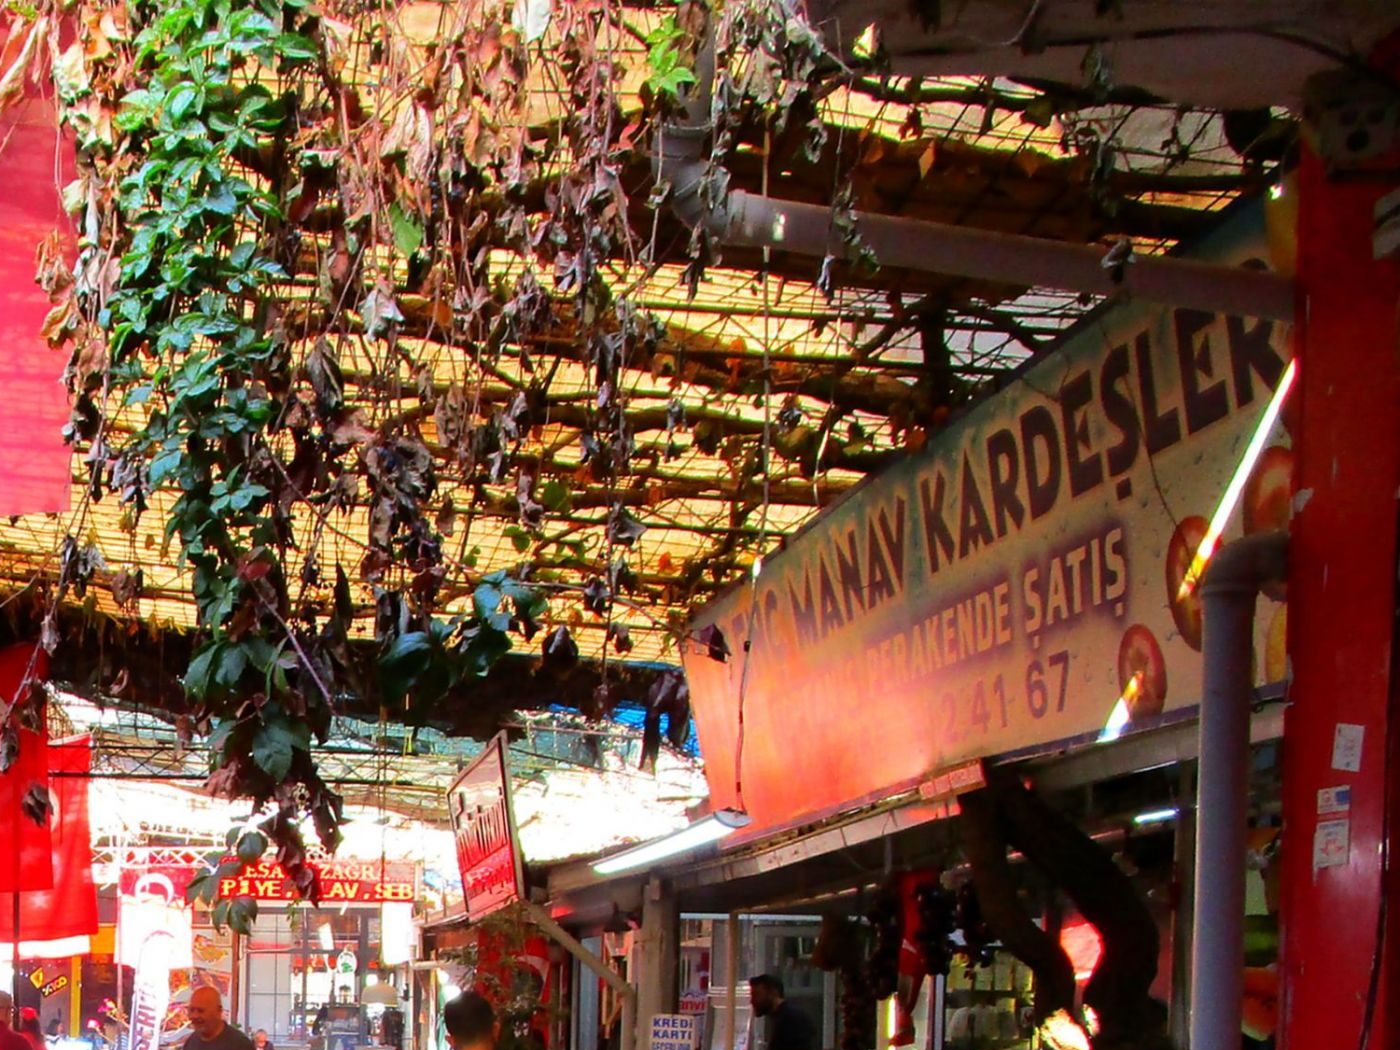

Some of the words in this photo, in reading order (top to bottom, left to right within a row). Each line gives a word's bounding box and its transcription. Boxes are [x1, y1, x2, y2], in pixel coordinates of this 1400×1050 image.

[786, 498, 905, 647] MANAV
[971, 673, 1008, 735] 41
[1025, 649, 1070, 720] 67
[653, 1018, 693, 1028] KREDİ
[653, 1029, 692, 1040] KARTI
